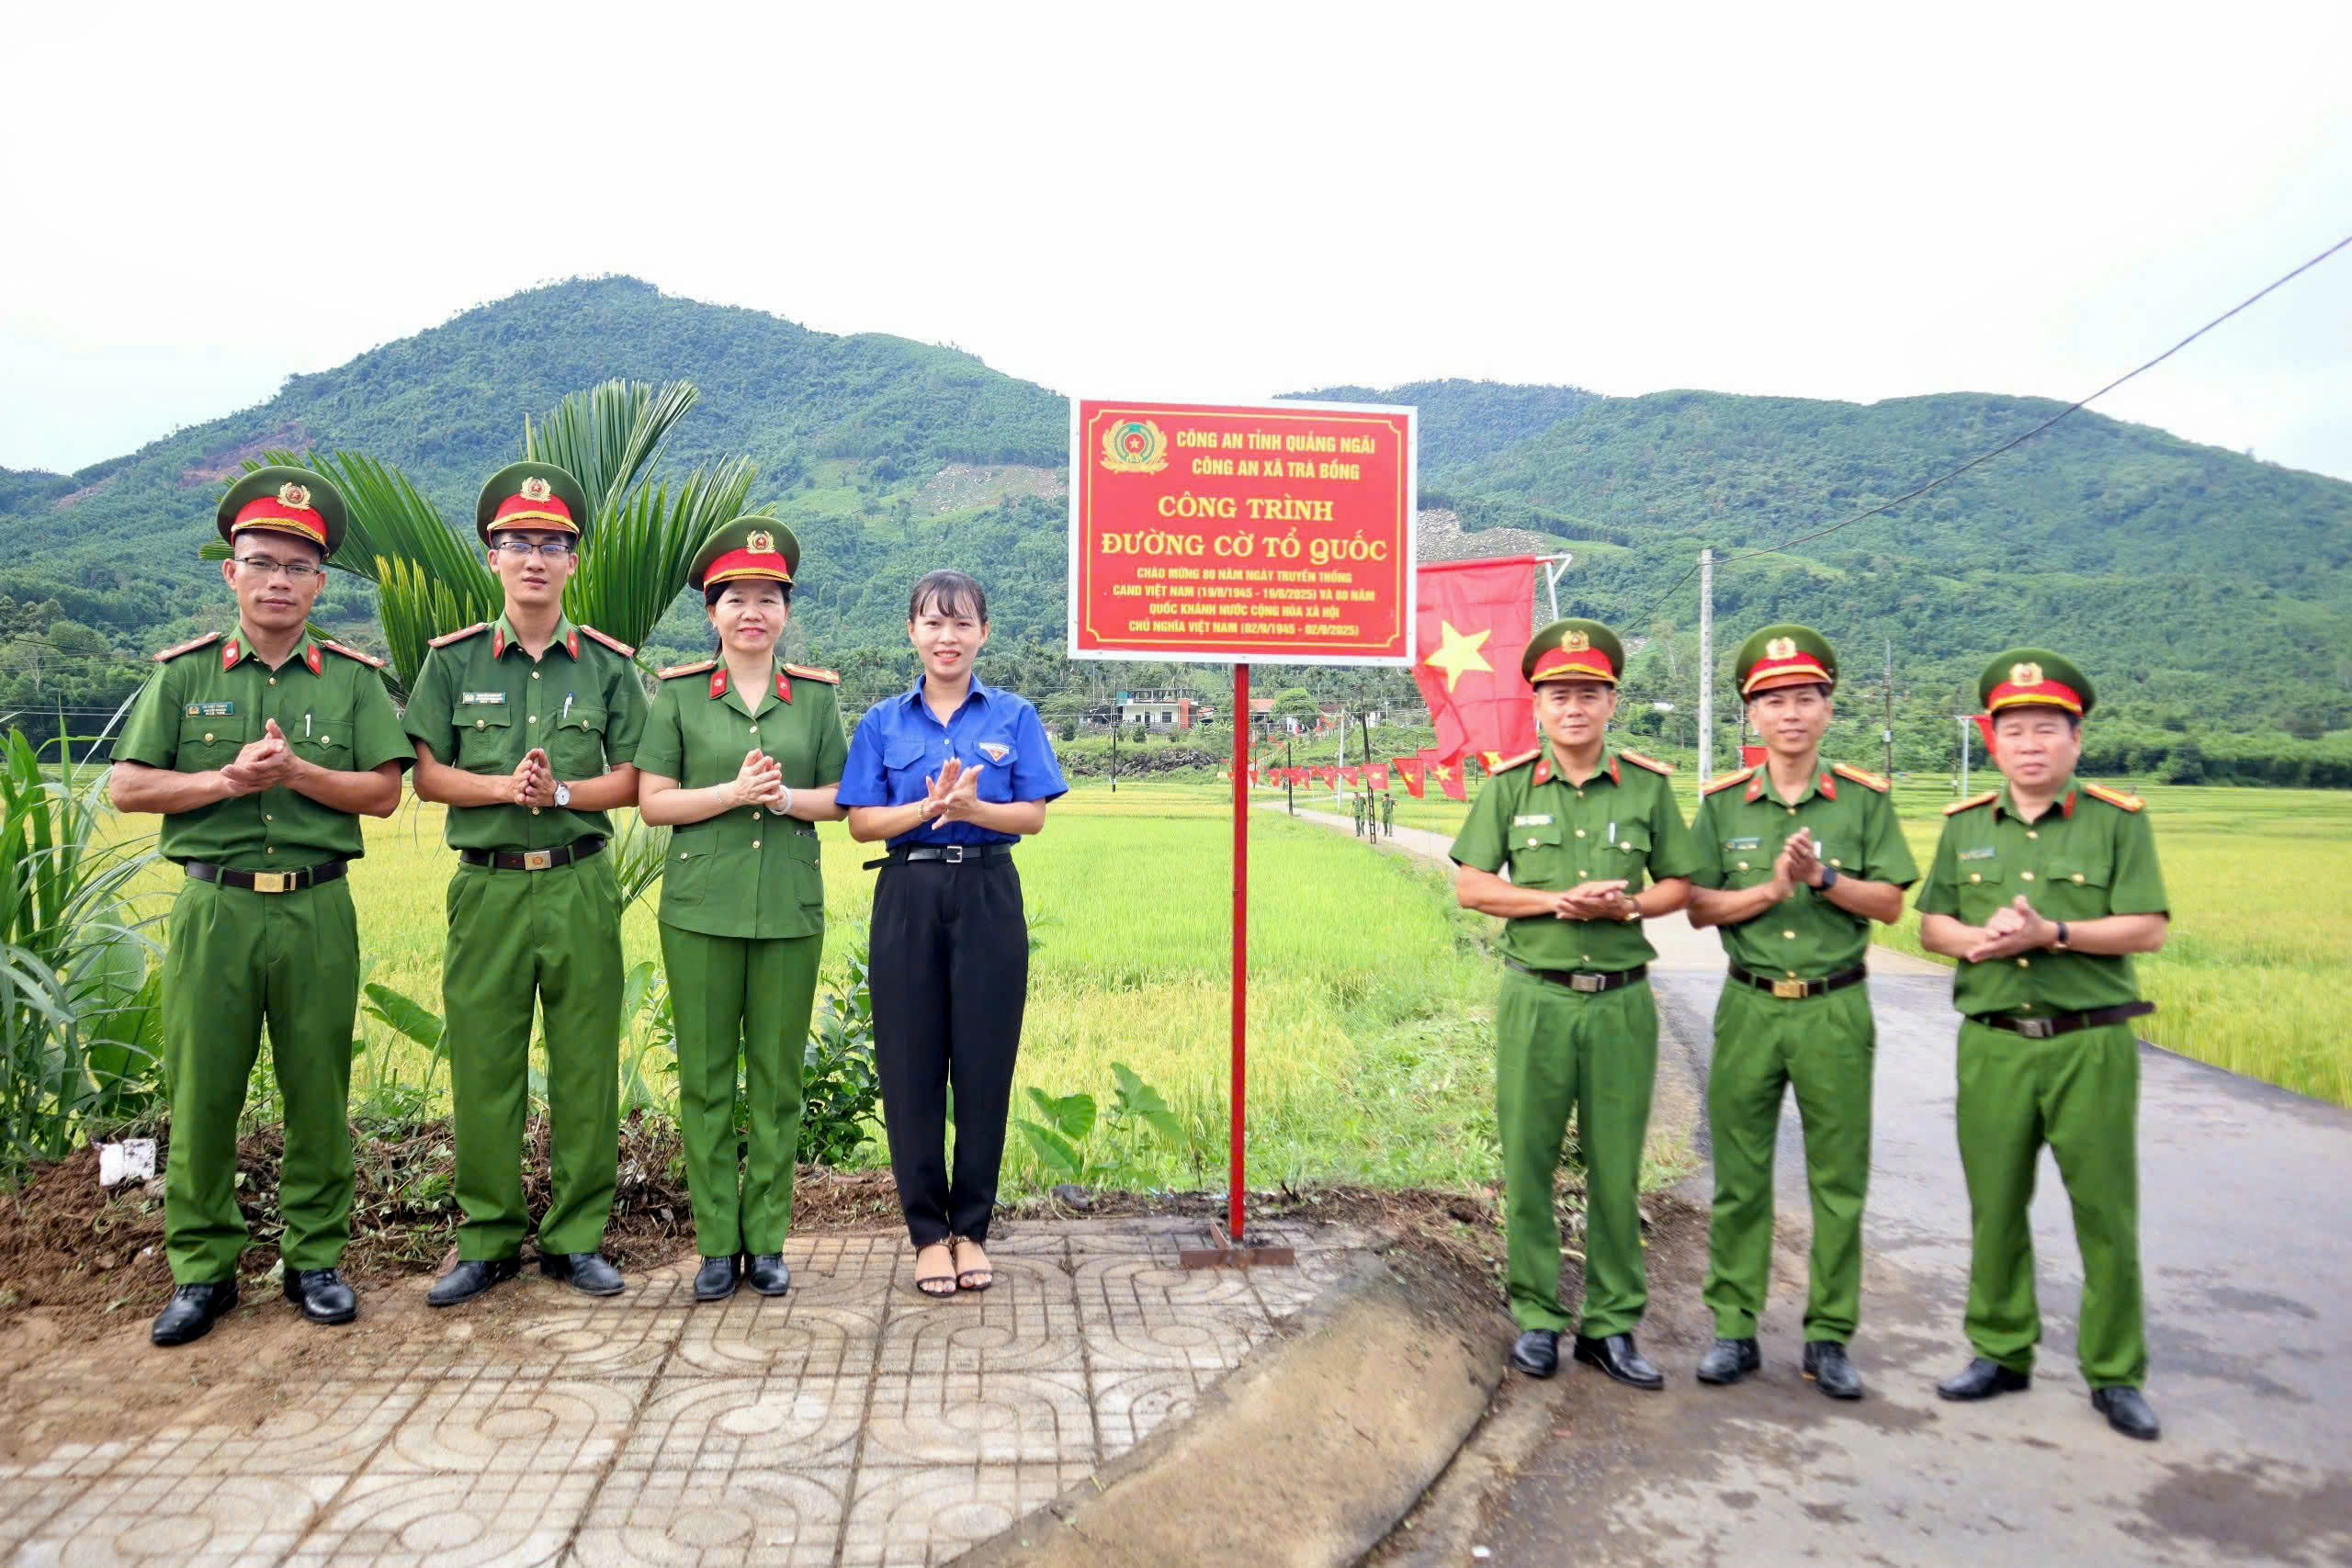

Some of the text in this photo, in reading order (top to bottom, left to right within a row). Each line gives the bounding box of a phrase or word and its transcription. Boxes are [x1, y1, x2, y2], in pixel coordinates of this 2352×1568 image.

[1177, 429, 1375, 454] CÔNG AN TỈNH QUẢNG NGÃI
[1193, 456, 1233, 475] CÔNG
[1238, 460, 1259, 477] AN
[1263, 457, 1283, 478] XÃ
[1288, 458, 1315, 479] TRÀ
[1159, 491, 1334, 521] CÔNG TRÌNH
[1102, 526, 1387, 564] ĐƯỜNG CỜ TỔ QUỐC
[1204, 570, 1215, 580] 80
[1113, 585, 1141, 596] CAND
[1146, 584, 1167, 598] VIỆT
[1170, 587, 1193, 596] NAM
[1189, 620, 1210, 635] VIỆT
[1213, 623, 1238, 633] NAM
